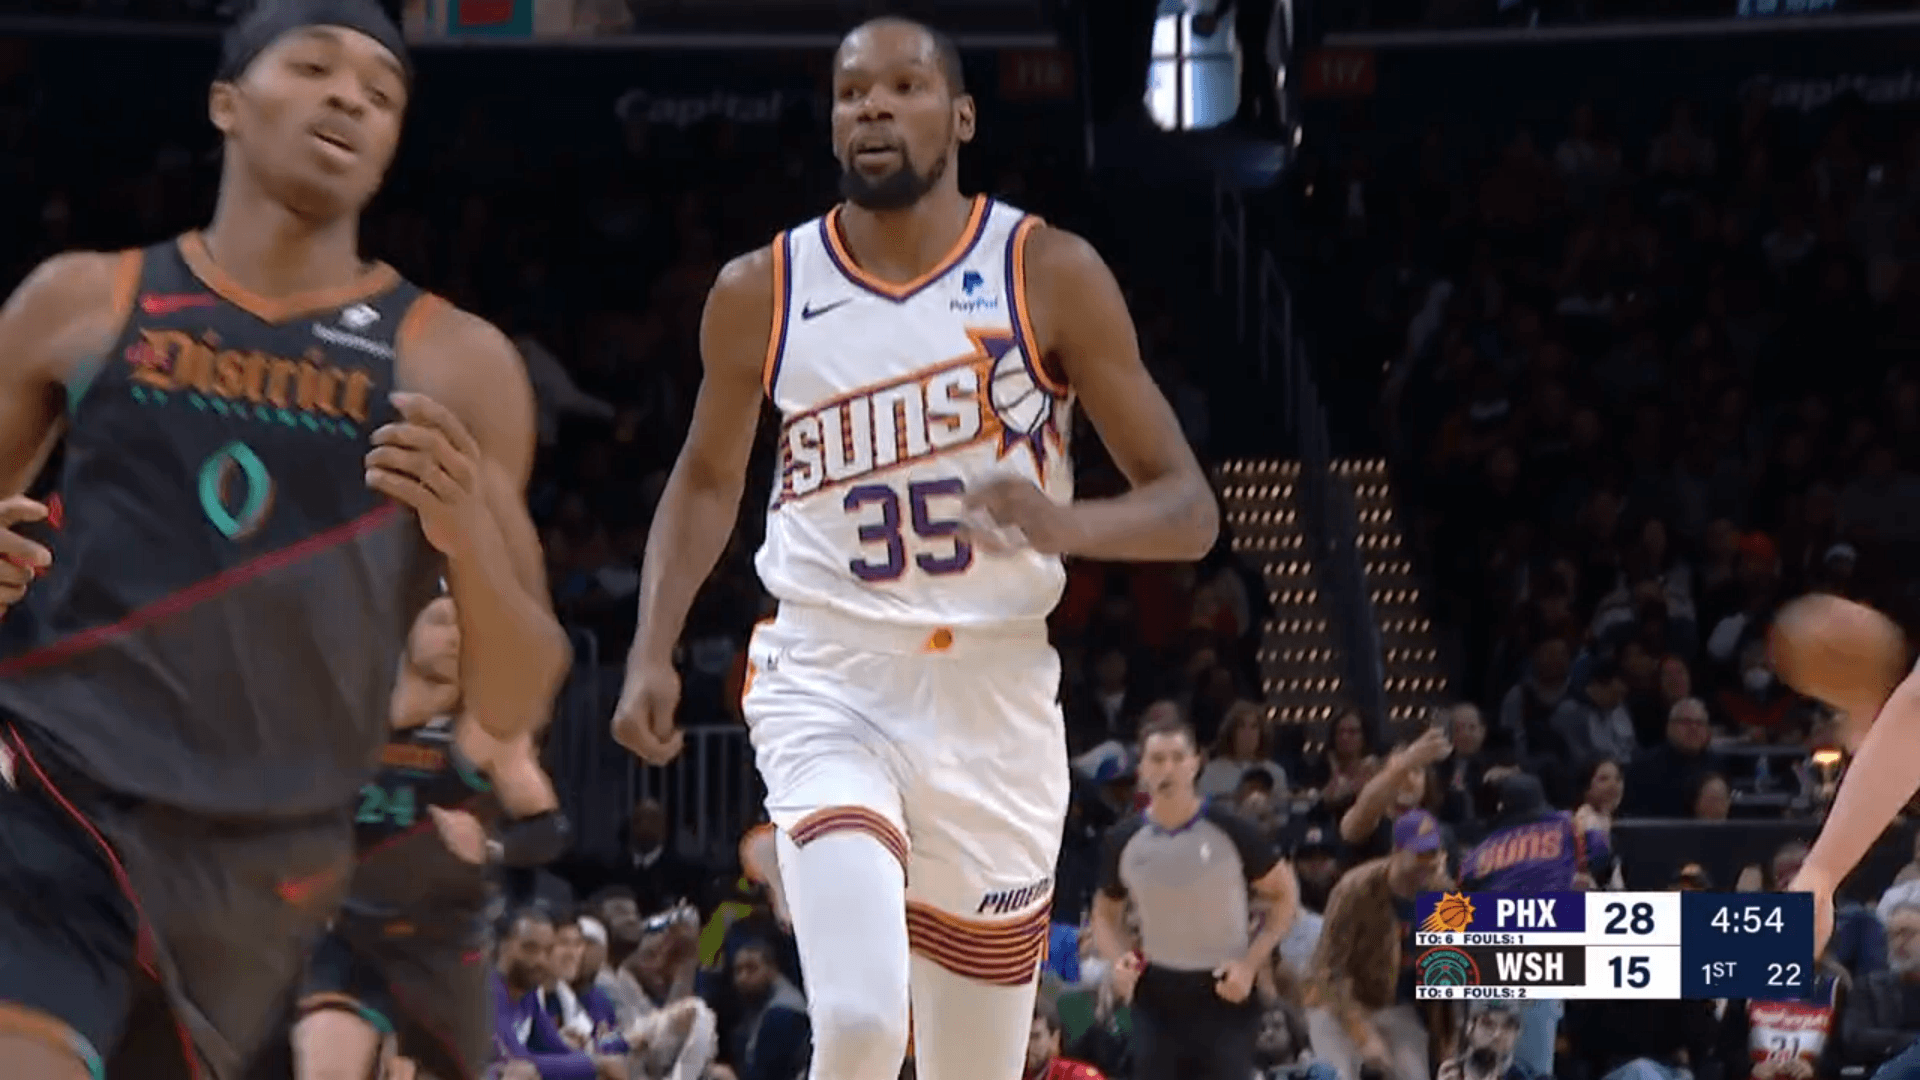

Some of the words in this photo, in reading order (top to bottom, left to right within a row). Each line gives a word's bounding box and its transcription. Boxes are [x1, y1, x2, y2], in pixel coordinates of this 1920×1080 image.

[949, 296, 999, 314] PayPal
[129, 327, 375, 422] District
[198, 440, 275, 541] 0
[843, 477, 973, 583] 35
[354, 782, 416, 827] 24
